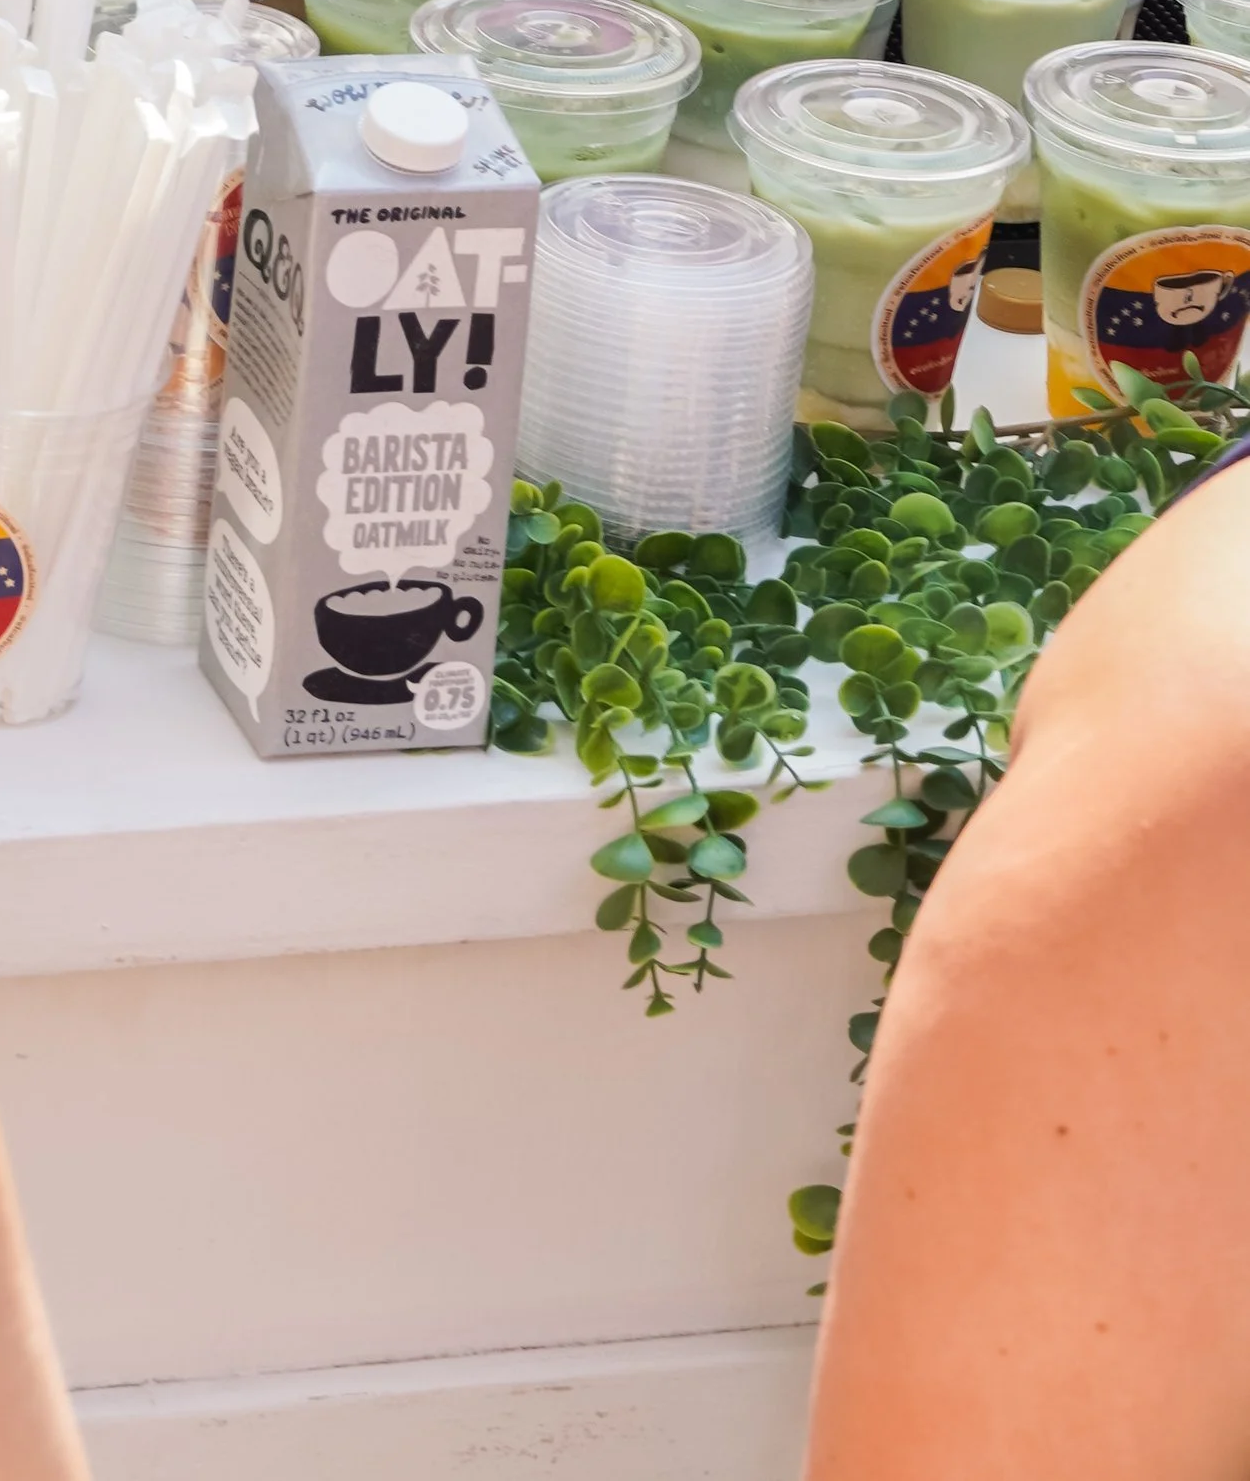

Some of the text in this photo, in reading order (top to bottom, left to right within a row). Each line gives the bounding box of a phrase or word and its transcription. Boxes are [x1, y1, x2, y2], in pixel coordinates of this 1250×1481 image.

[331, 205, 467, 224] THE ORIGINAL
[326, 226, 528, 311] OAT-
[350, 311, 495, 394] LY!
[342, 433, 468, 474] BARISTA
[345, 473, 462, 515] EDITION
[352, 518, 450, 549] OATMILK
[424, 686, 476, 712] 0.75
[285, 708, 306, 724] 32
[335, 711, 355, 723] oz
[306, 725, 336, 746] qt)
[342, 724, 382, 744] (946
[384, 722, 417, 742] mL)
